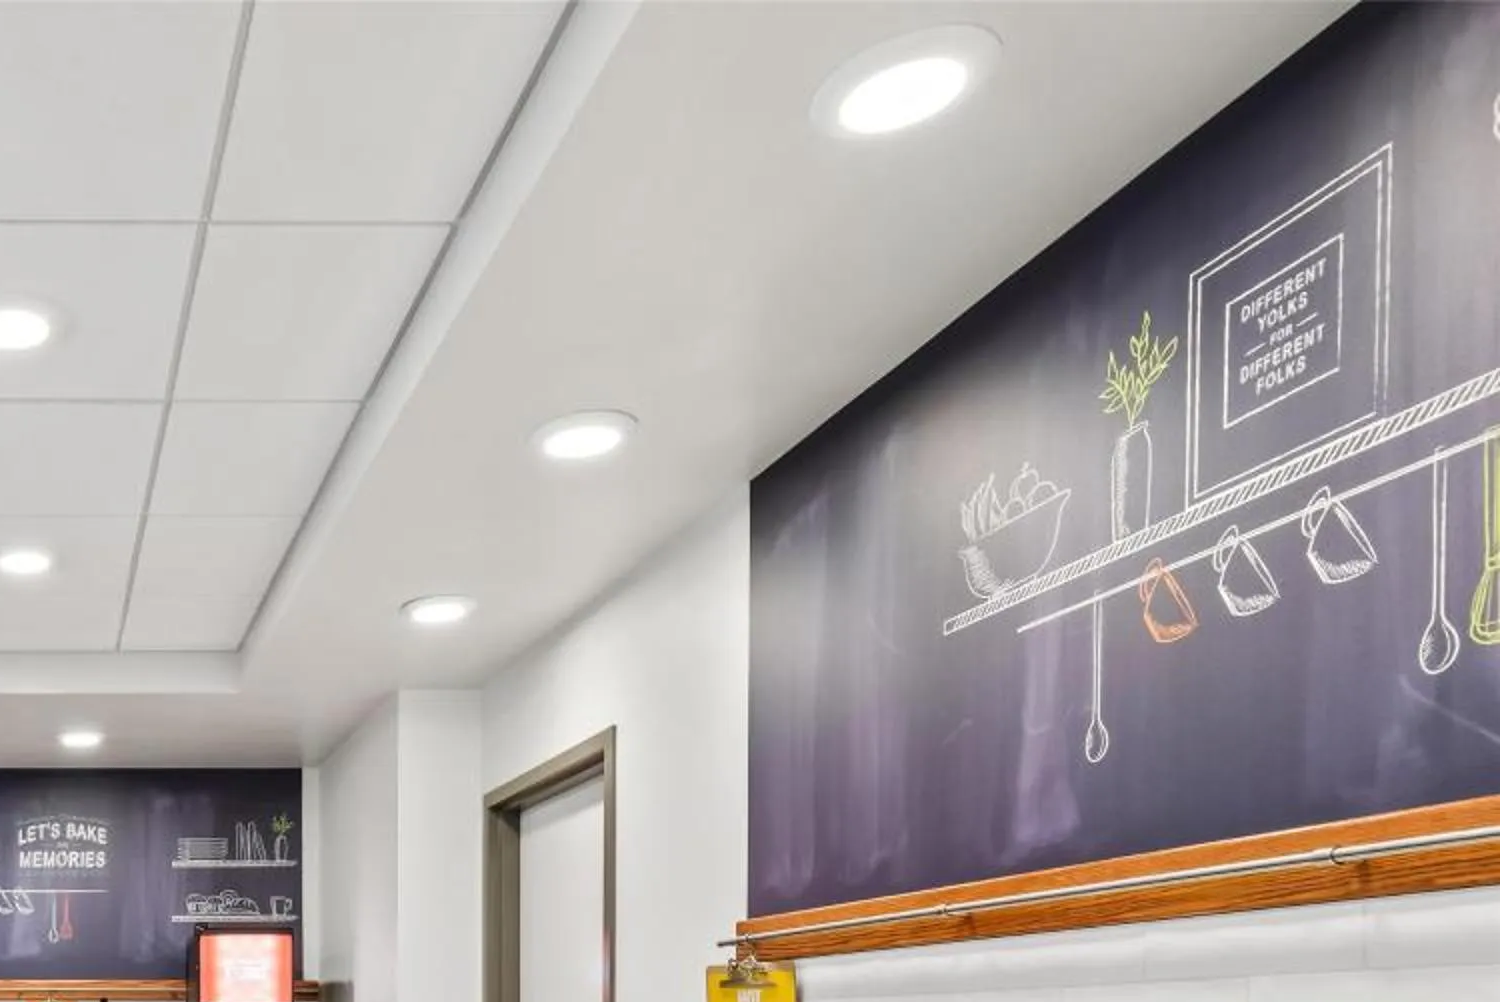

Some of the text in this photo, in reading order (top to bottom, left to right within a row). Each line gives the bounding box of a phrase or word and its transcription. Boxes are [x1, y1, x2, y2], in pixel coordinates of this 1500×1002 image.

[1240, 257, 1327, 324] DIFFERENT
[1257, 291, 1308, 333] YOLKS
[1239, 323, 1325, 385] DIFFERENT
[1269, 323, 1293, 346] FOR
[1255, 356, 1307, 396] FOLKS
[18, 822, 108, 845] LET'S BAKE
[19, 851, 106, 869] MEMORIES
